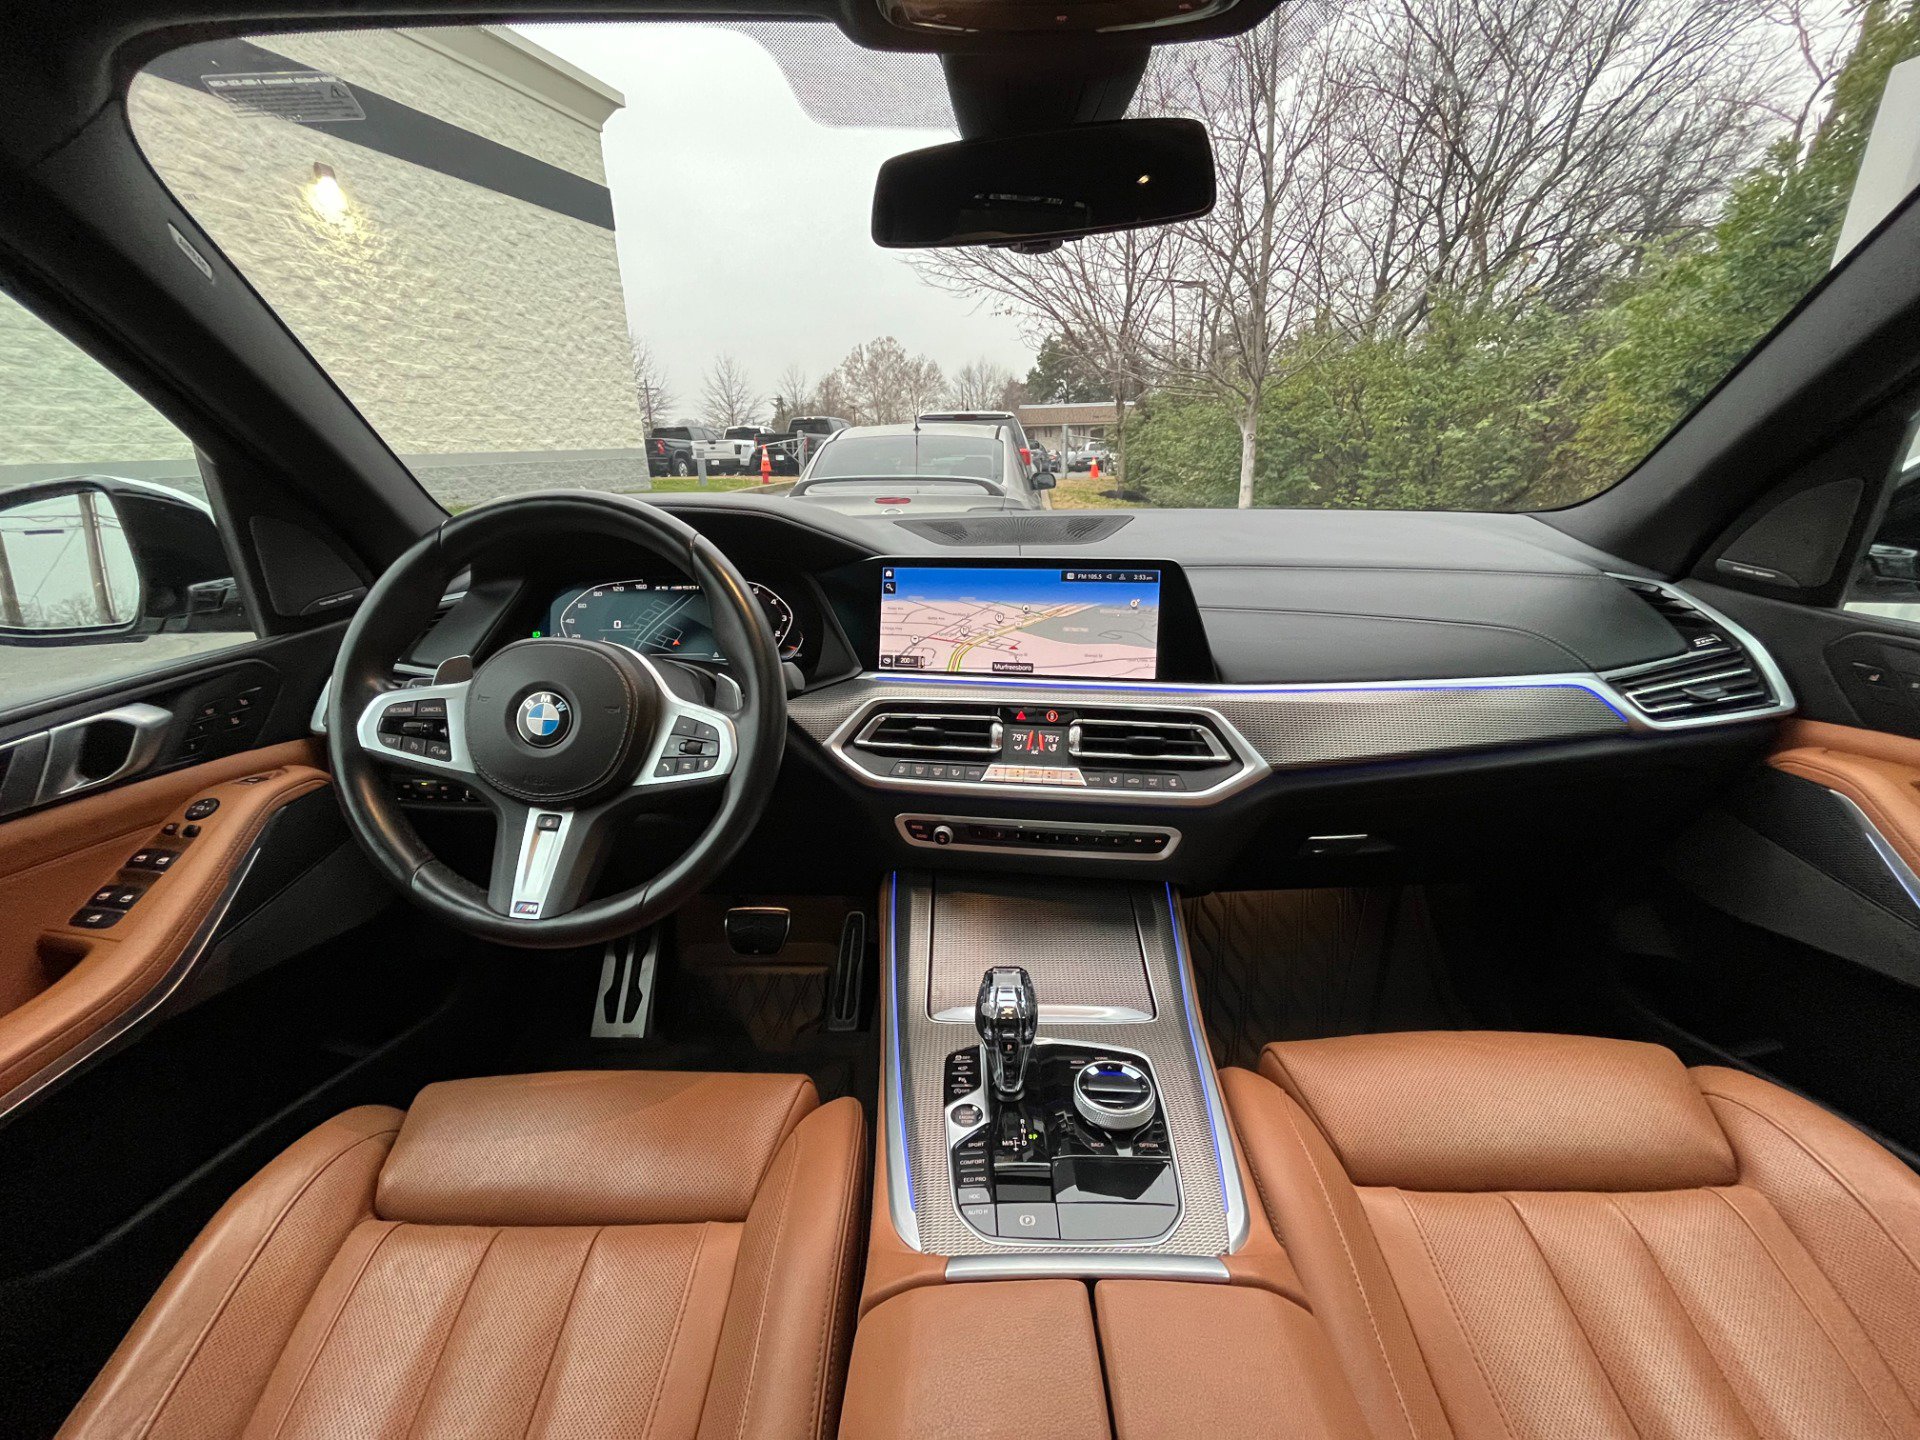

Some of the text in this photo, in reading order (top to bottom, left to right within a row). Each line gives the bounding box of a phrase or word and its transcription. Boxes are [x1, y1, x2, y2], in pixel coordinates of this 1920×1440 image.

[781, 614, 787, 622] 3
[900, 656, 910, 664] 200
[994, 663, 1032, 672] Murfreesboro
[524, 693, 567, 712] BMW
